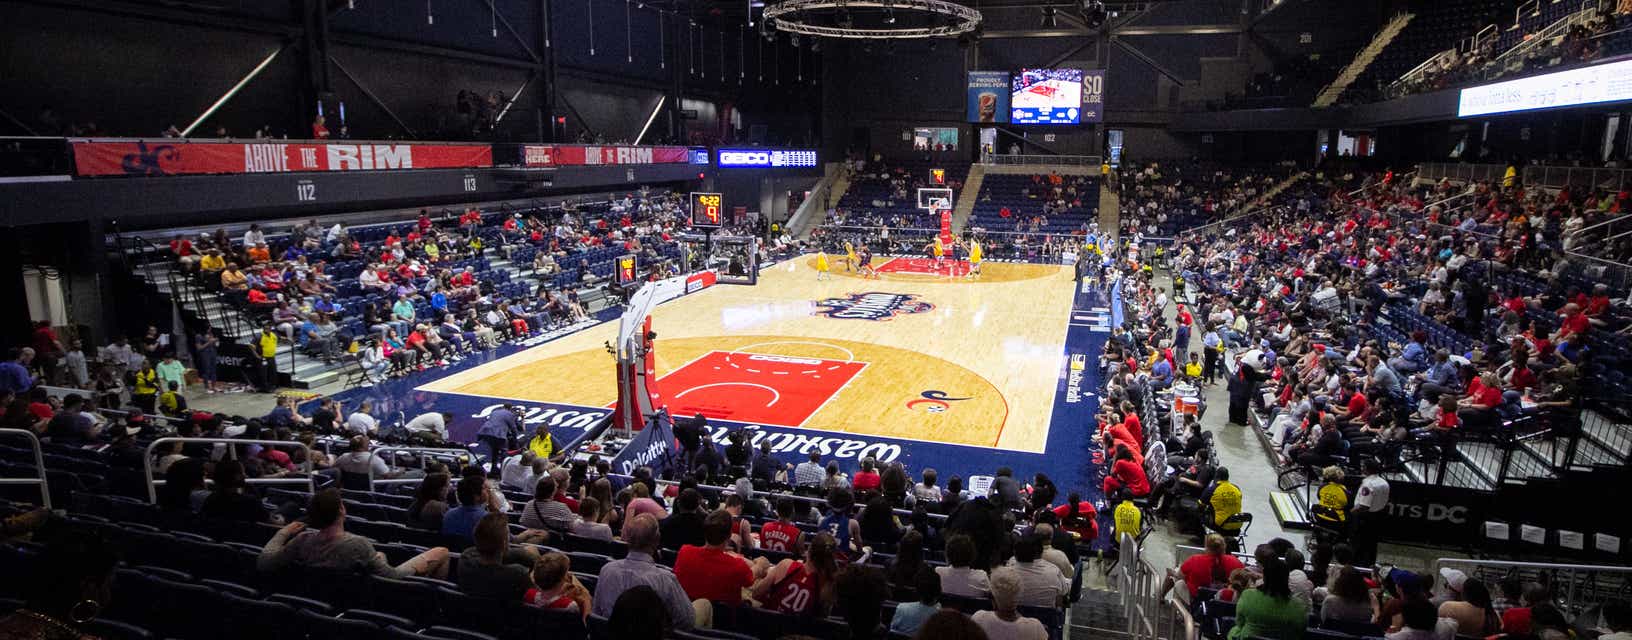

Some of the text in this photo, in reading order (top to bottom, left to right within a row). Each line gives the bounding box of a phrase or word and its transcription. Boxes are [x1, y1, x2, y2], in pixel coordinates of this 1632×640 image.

[1084, 76, 1102, 94] SO
[1083, 95, 1101, 103] CLOSE
[245, 144, 412, 172] ABOVE THE RIM
[617, 147, 652, 164] RIM
[720, 152, 769, 164] GEICO
[297, 184, 316, 200] 112
[464, 178, 476, 191] 113
[699, 195, 720, 206] 9:22
[707, 206, 717, 222] 9
[1427, 503, 1469, 524] DC
[828, 522, 840, 537] 3
[781, 583, 810, 612] 20
